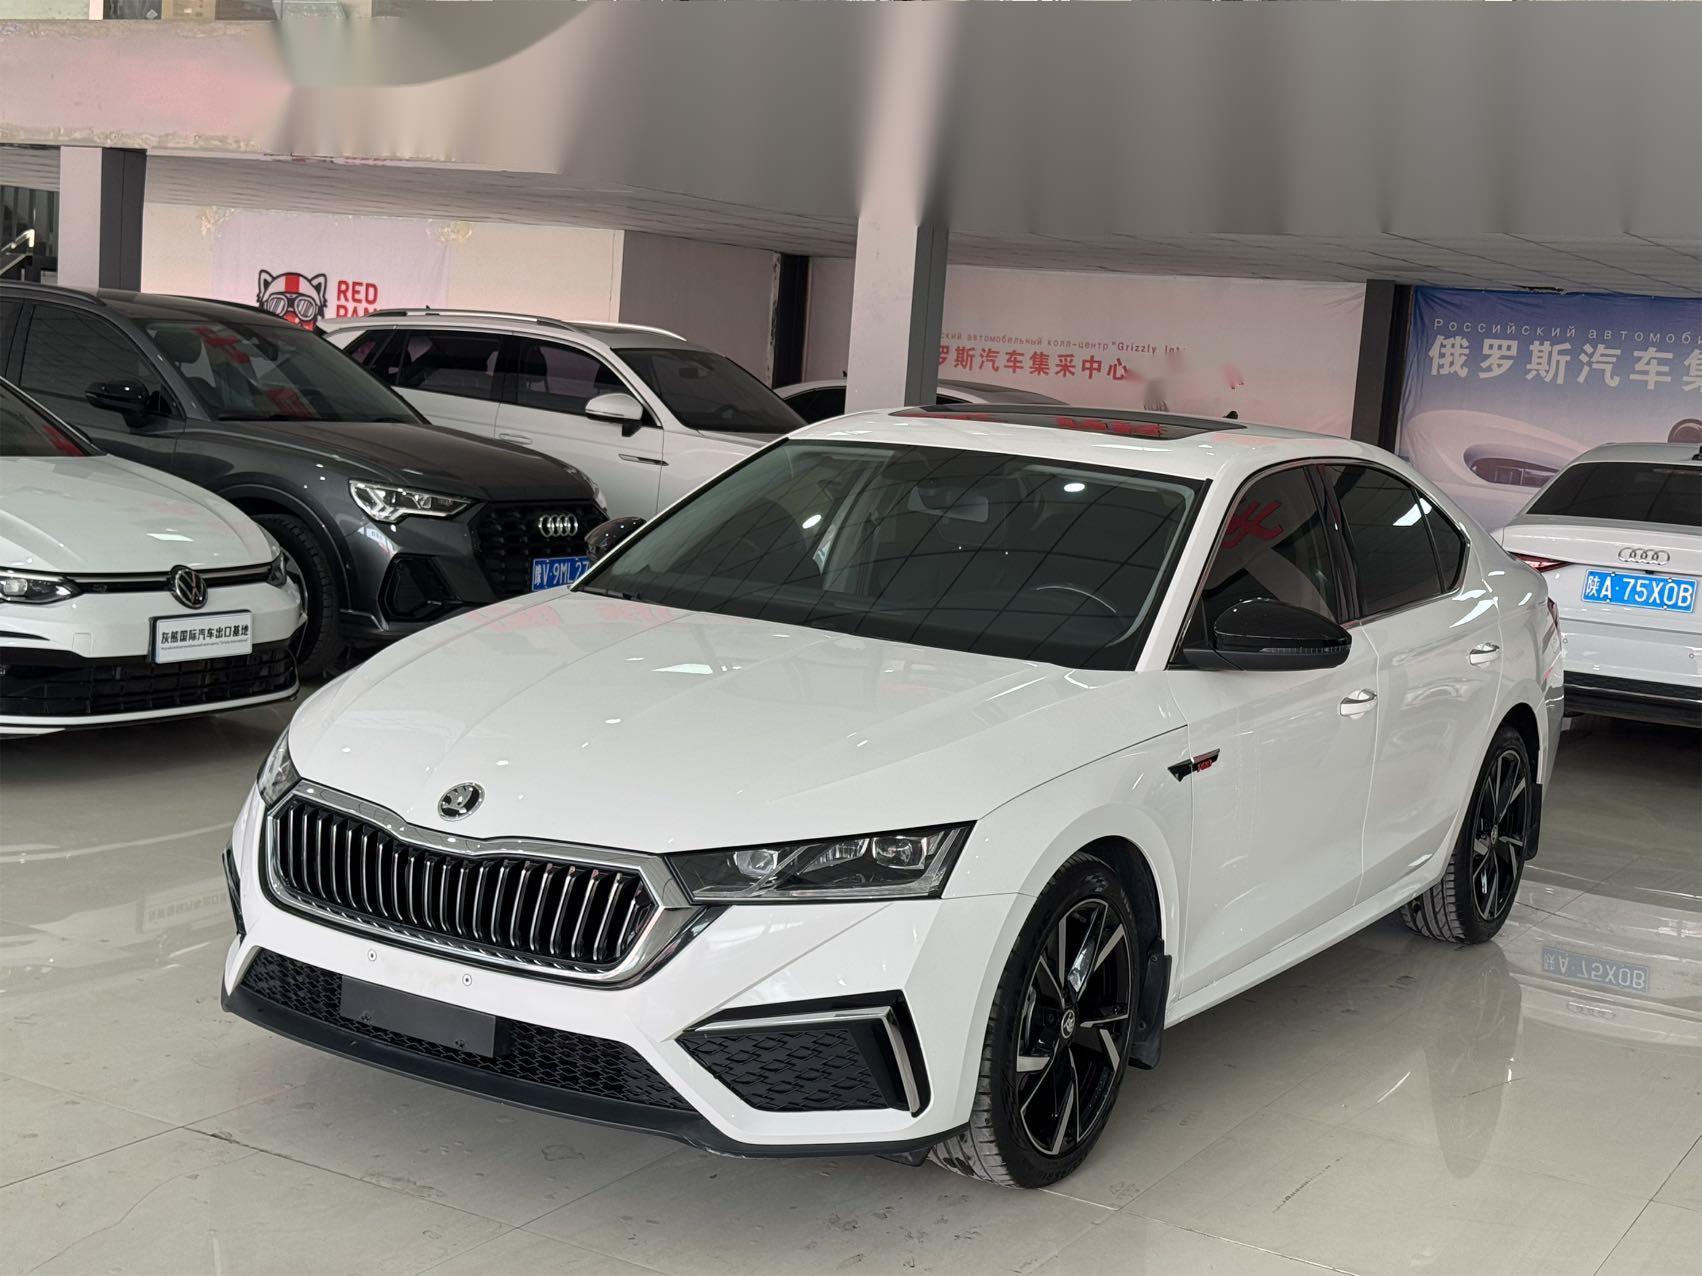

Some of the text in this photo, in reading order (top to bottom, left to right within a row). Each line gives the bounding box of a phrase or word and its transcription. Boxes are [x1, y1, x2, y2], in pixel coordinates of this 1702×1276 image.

[336, 280, 379, 305] RED
[1433, 318, 1577, 338] Российский
[1047, 339, 1109, 351] колл-центр
